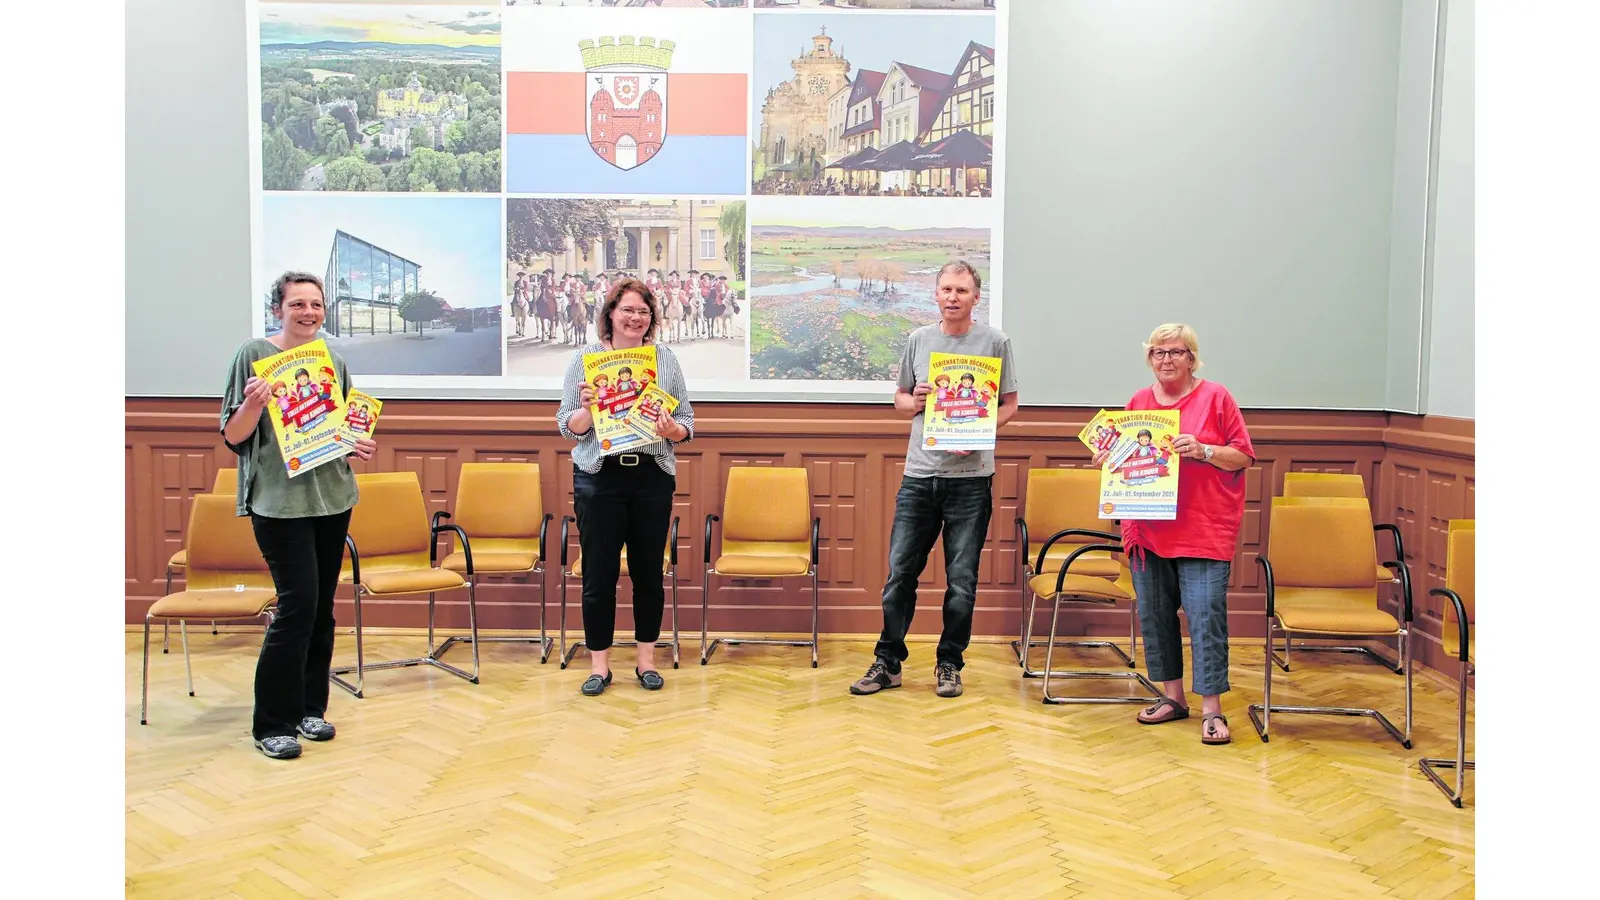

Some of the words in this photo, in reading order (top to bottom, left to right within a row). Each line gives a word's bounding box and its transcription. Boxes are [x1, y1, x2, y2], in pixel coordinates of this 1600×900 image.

[261, 353, 294, 379] FERIENAKTION
[294, 350, 326, 359] BÜCKEBURG
[588, 354, 622, 370] FERIENAKTION
[624, 352, 653, 362] BÜCKEBURG
[598, 360, 632, 371] SOMMERFERIEN
[932, 358, 968, 369] FERIENAKTION
[970, 358, 998, 374] BÜCKEBURG
[272, 358, 305, 378] SOMMERFERIEN
[976, 367, 988, 375] 2021
[615, 390, 635, 401] AKTIONEN
[614, 403, 623, 411] FÜR
[1144, 413, 1176, 428] BÜCKEBURG
[311, 426, 337, 442] September
[1131, 457, 1154, 466] AKTIONEN
[1128, 469, 1139, 477] FÜR
[1139, 466, 1158, 475] KINDER
